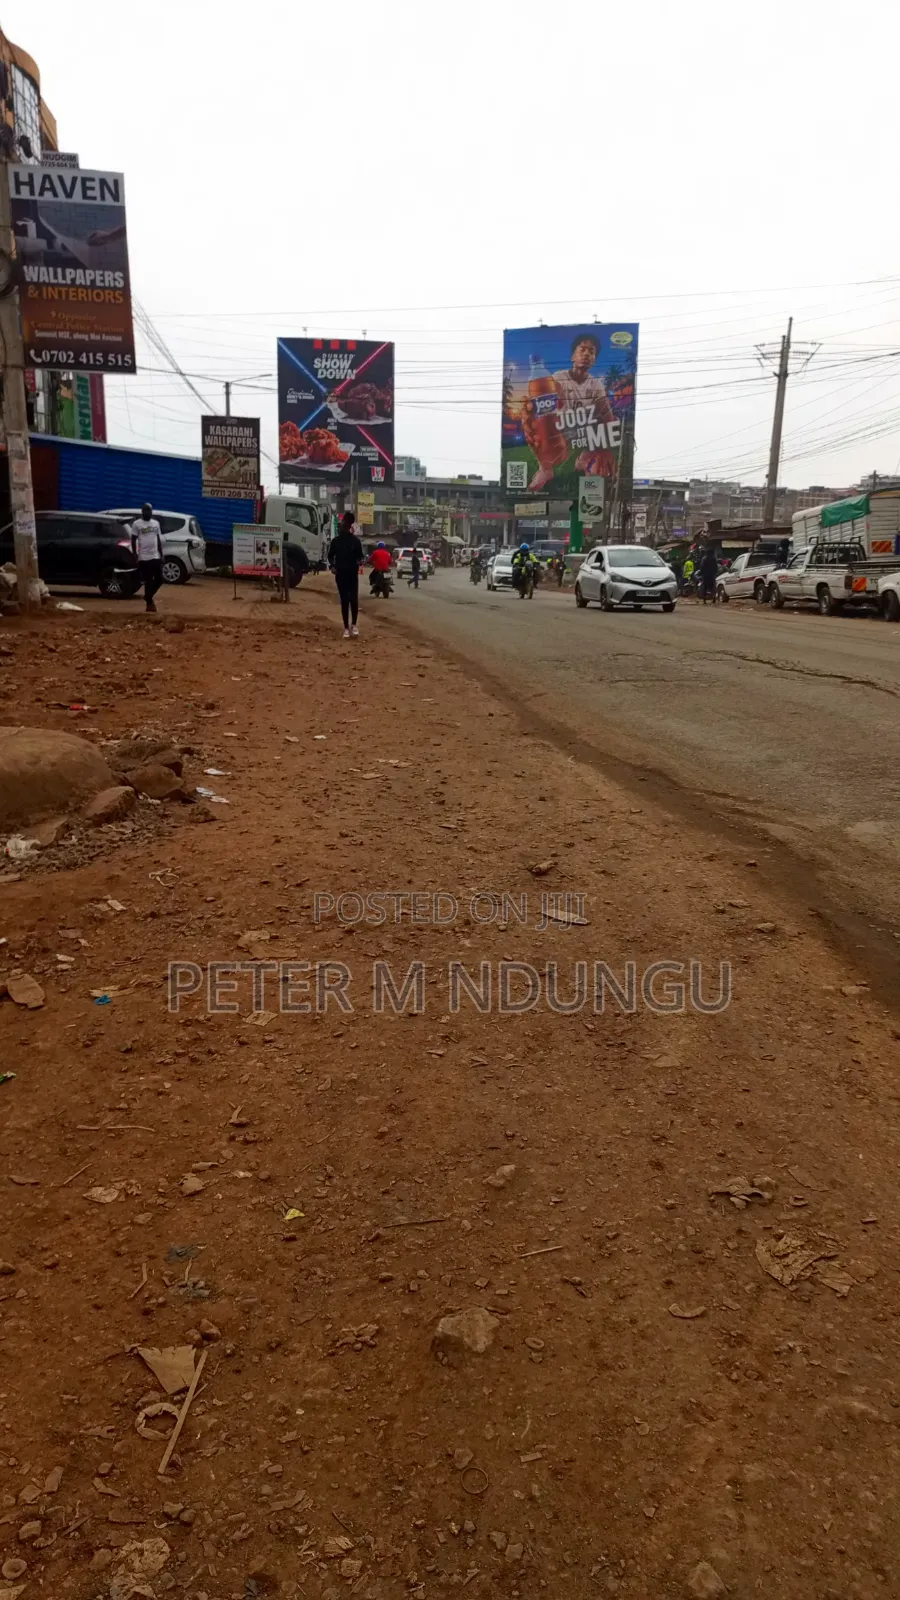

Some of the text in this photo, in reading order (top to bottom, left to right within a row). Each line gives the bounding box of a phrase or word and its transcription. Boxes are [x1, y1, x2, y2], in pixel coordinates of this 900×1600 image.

[13, 171, 121, 203] HAVEN
[23, 265, 125, 288] WALLPAPERS
[27, 285, 124, 304] & INTERIORS
[41, 349, 132, 366] 0702 415 515
[313, 357, 352, 369] SHOW
[317, 368, 357, 380] DOWN
[555, 405, 598, 430] JOOZ
[209, 425, 253, 437] KASARANI
[577, 428, 585, 438] IT
[586, 420, 621, 452] ME
[204, 435, 258, 448] WALLPAPERS
[571, 439, 588, 449] FOR
